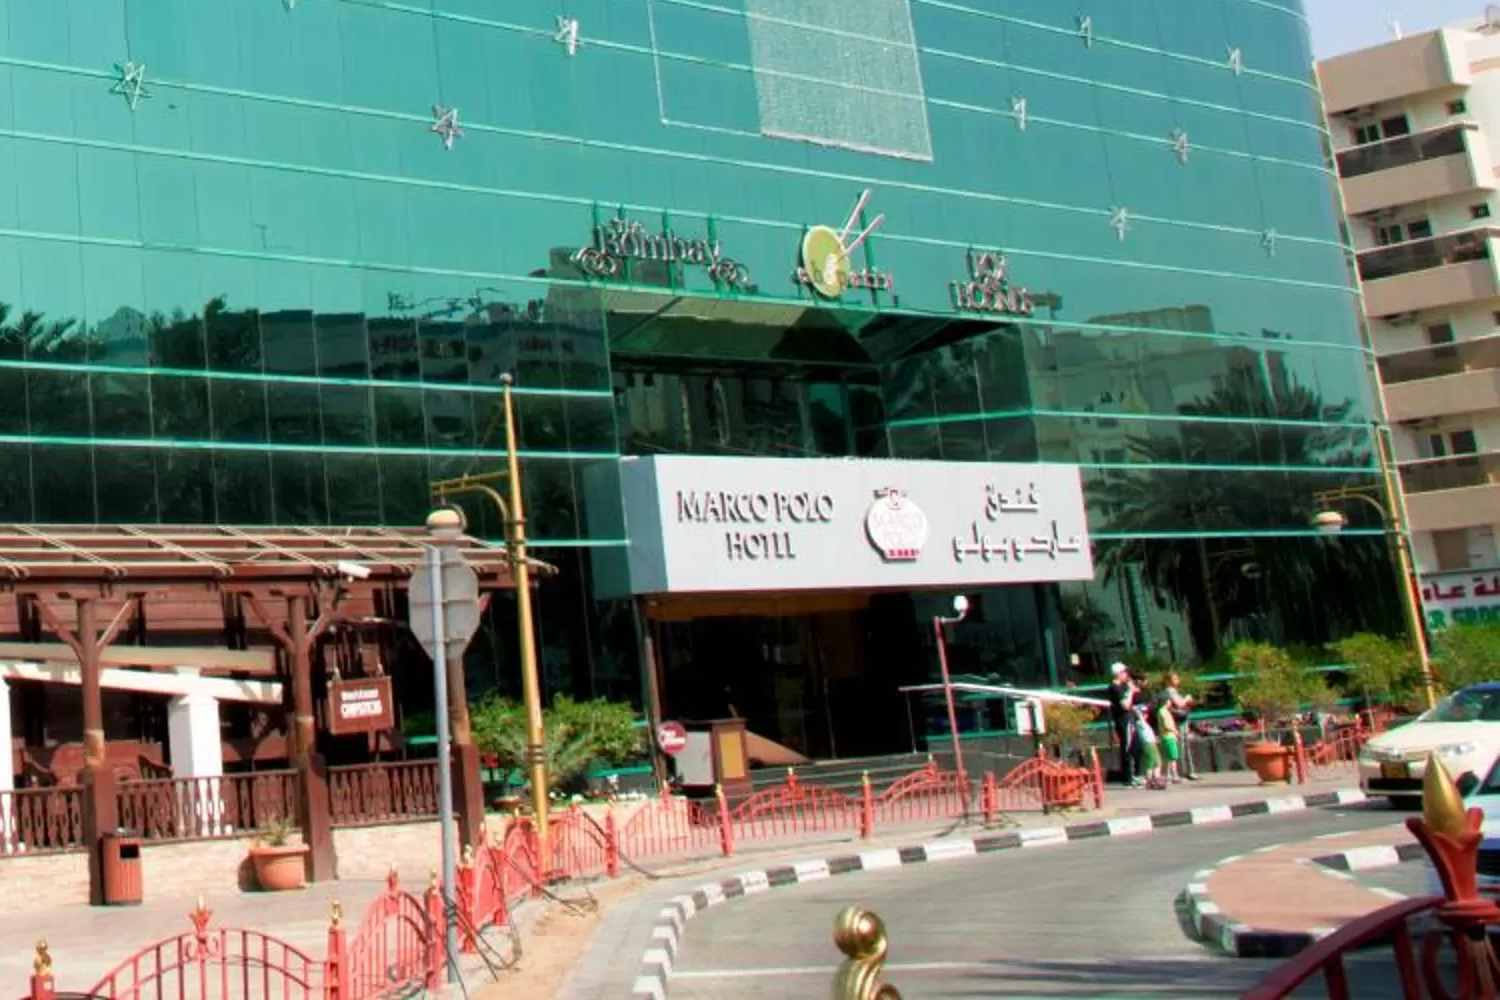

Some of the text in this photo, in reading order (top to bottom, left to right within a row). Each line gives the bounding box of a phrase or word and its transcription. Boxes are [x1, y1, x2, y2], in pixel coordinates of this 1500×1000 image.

[676, 488, 834, 523] MARCO POLO
[726, 531, 797, 560] HOTEL
